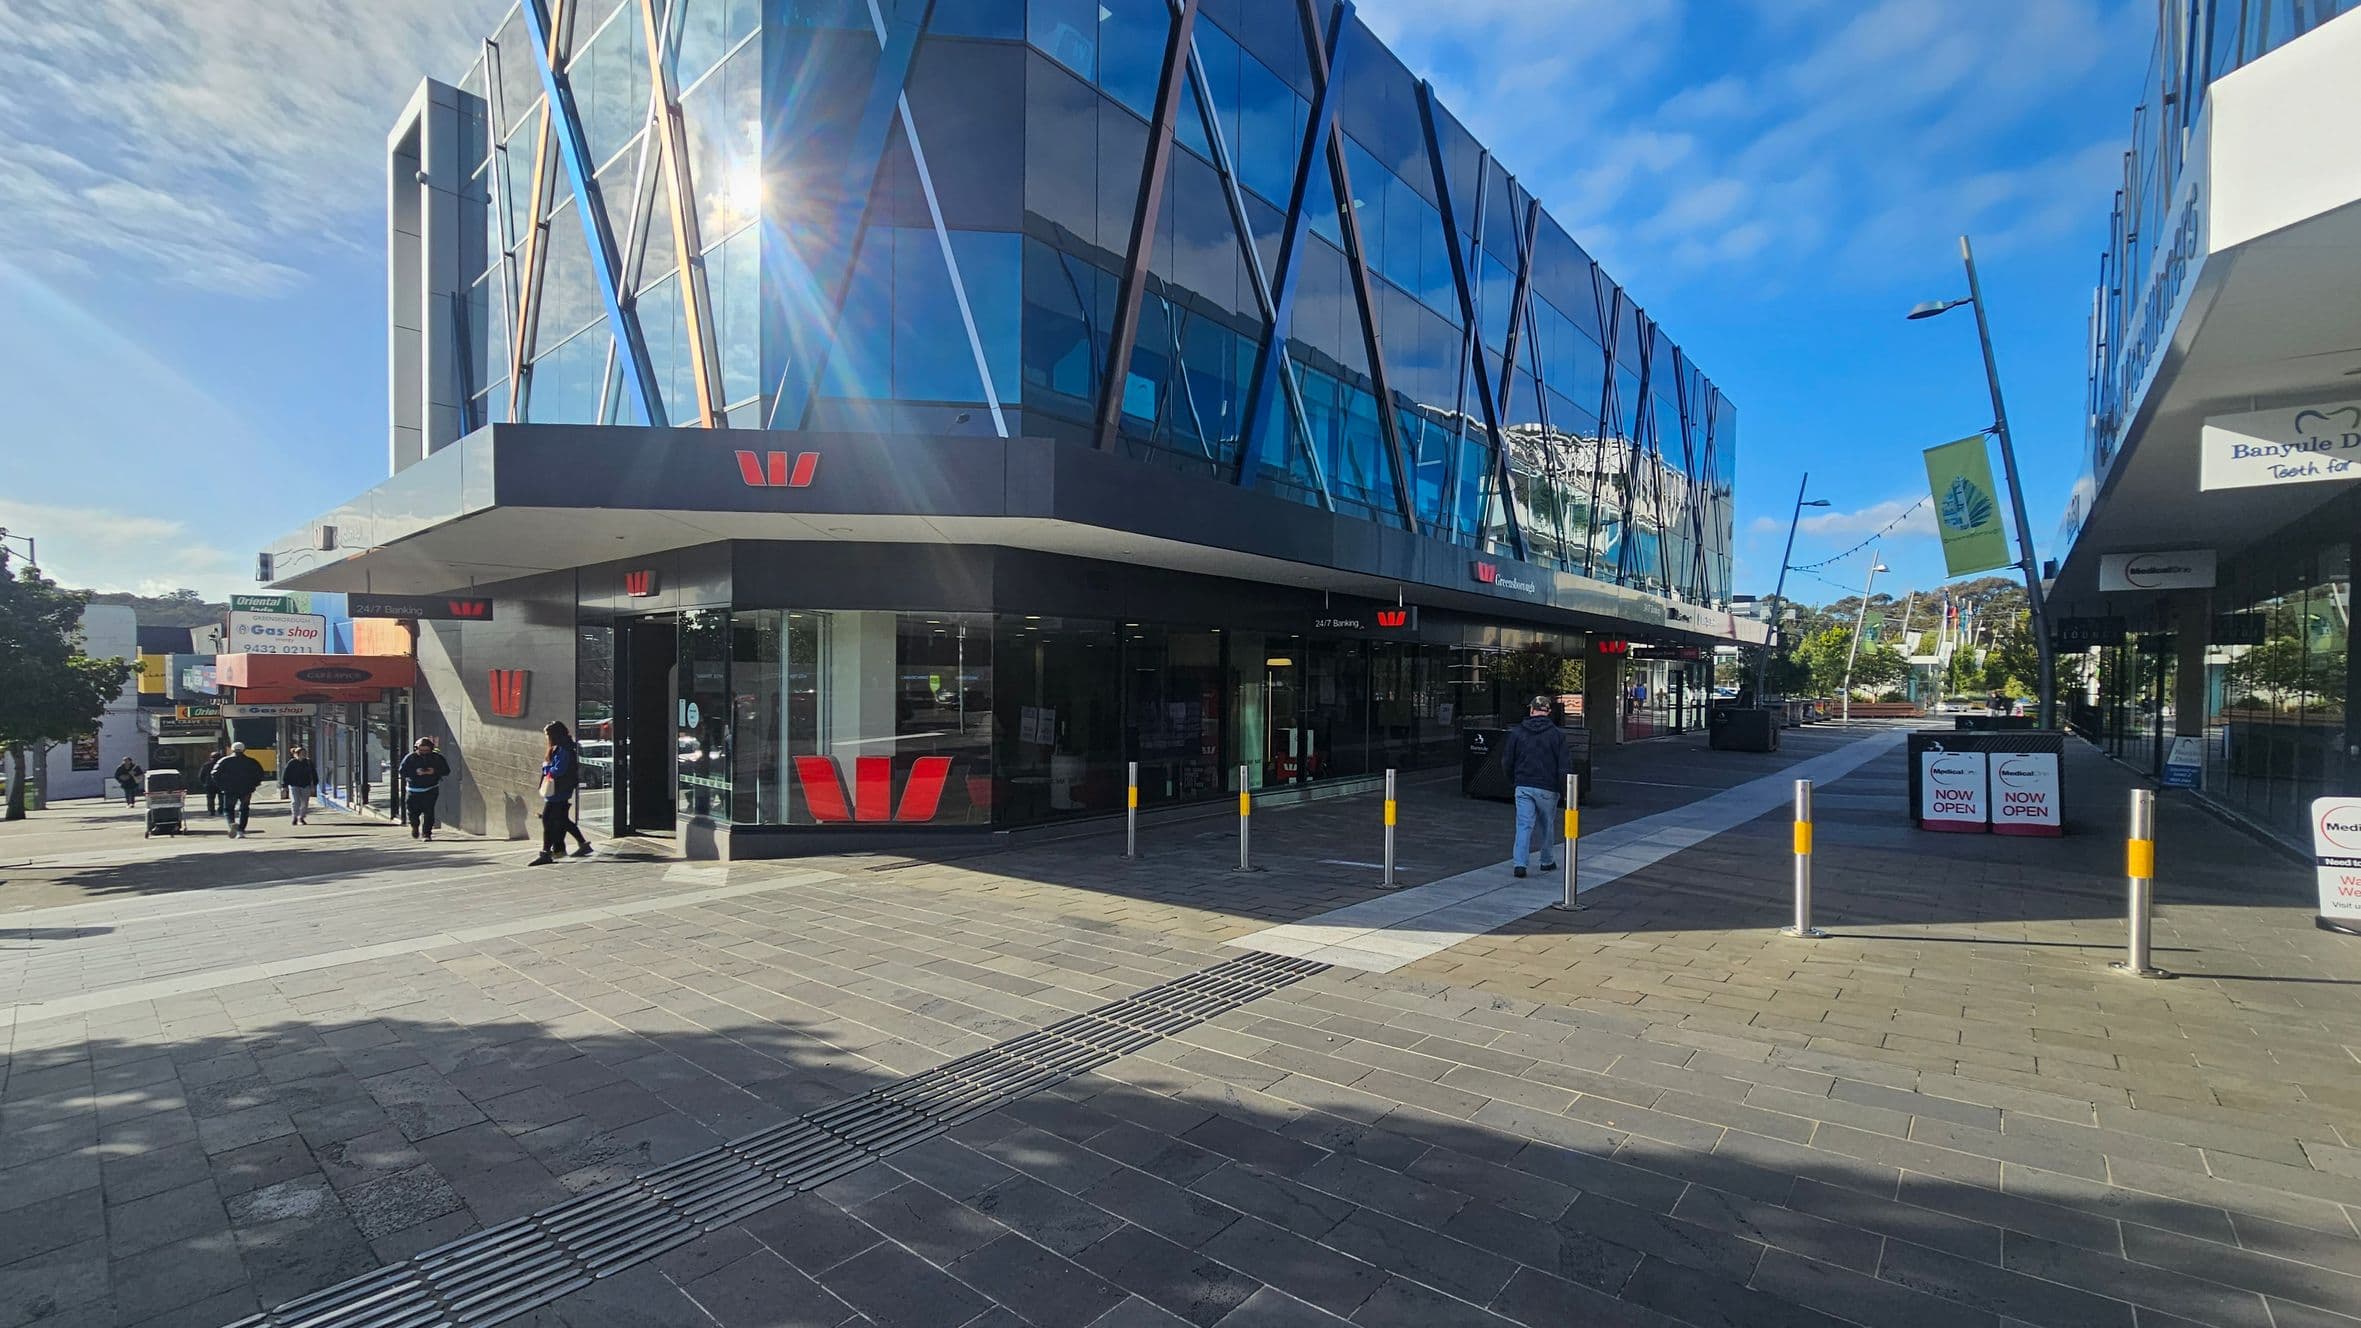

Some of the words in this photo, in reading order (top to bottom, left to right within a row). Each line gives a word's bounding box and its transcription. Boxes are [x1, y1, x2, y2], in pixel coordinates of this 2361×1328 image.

[2231, 436, 2333, 459] Banyule
[2340, 432, 2361, 449] D
[2267, 462, 2321, 480] Teeth
[2326, 458, 2353, 474] for
[1495, 573, 1535, 594] Greensborough
[237, 596, 282, 606] Oriental
[356, 605, 381, 614] 24/7
[385, 605, 423, 616] Banking
[1315, 619, 1331, 628] 24/7
[1333, 619, 1359, 629] Banking
[251, 625, 284, 636] Gas
[287, 626, 318, 640] shop
[243, 644, 277, 653] 9432
[1935, 789, 1974, 801] NOW
[2005, 792, 2046, 803] NOW
[1933, 802, 1976, 815] OPEN
[2002, 805, 2048, 817] OPEN
[2325, 858, 2351, 866] Need
[2332, 902, 2352, 910] Visit
